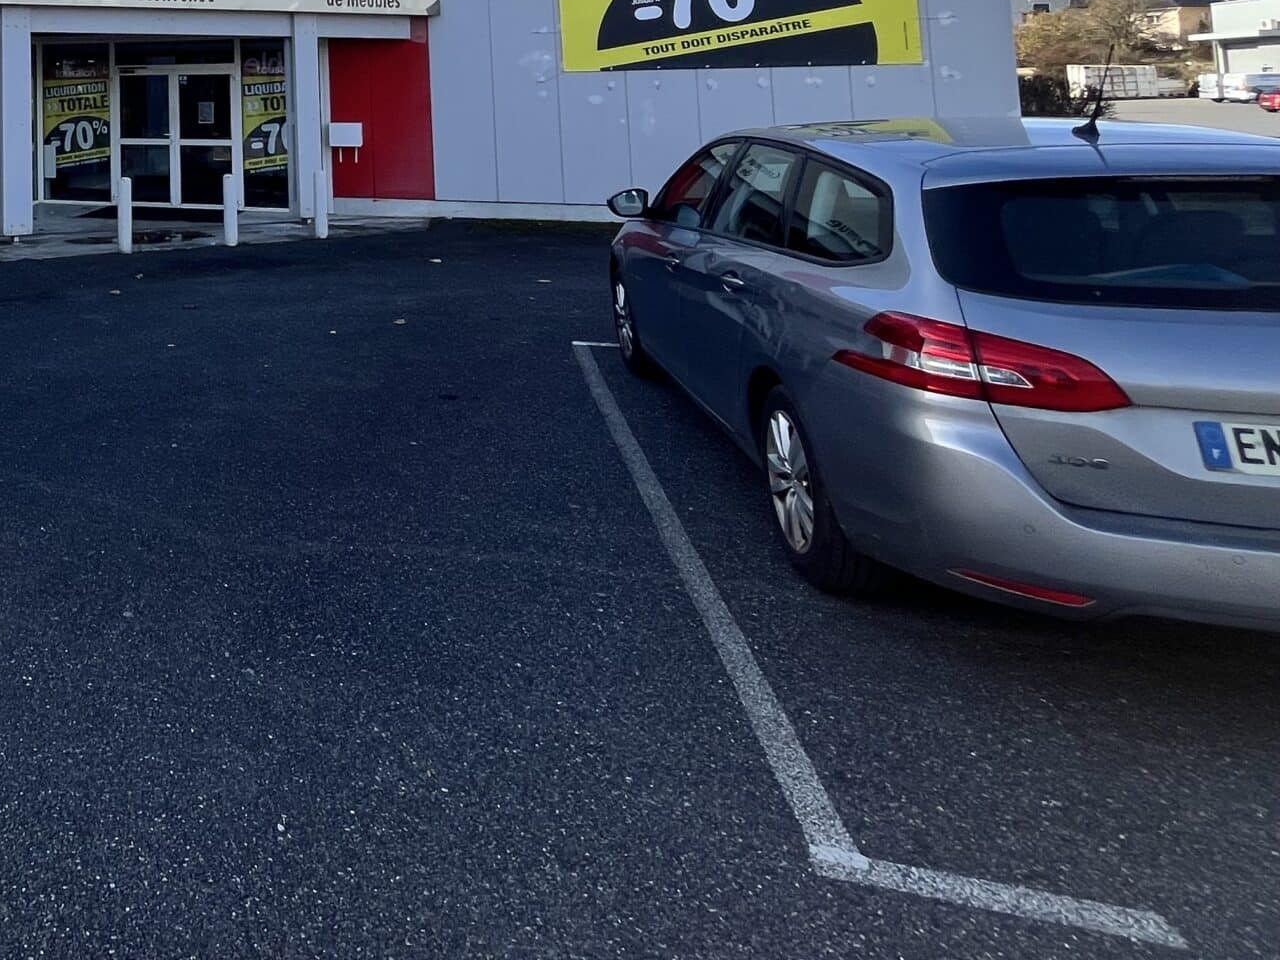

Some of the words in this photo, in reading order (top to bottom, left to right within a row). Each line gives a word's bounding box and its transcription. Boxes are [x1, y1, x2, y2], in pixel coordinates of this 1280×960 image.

[643, 42, 677, 56] TOUT
[681, 36, 712, 50] DOIT
[717, 19, 812, 43] DISPARAÎTRE
[58, 95, 109, 112] TOTALE
